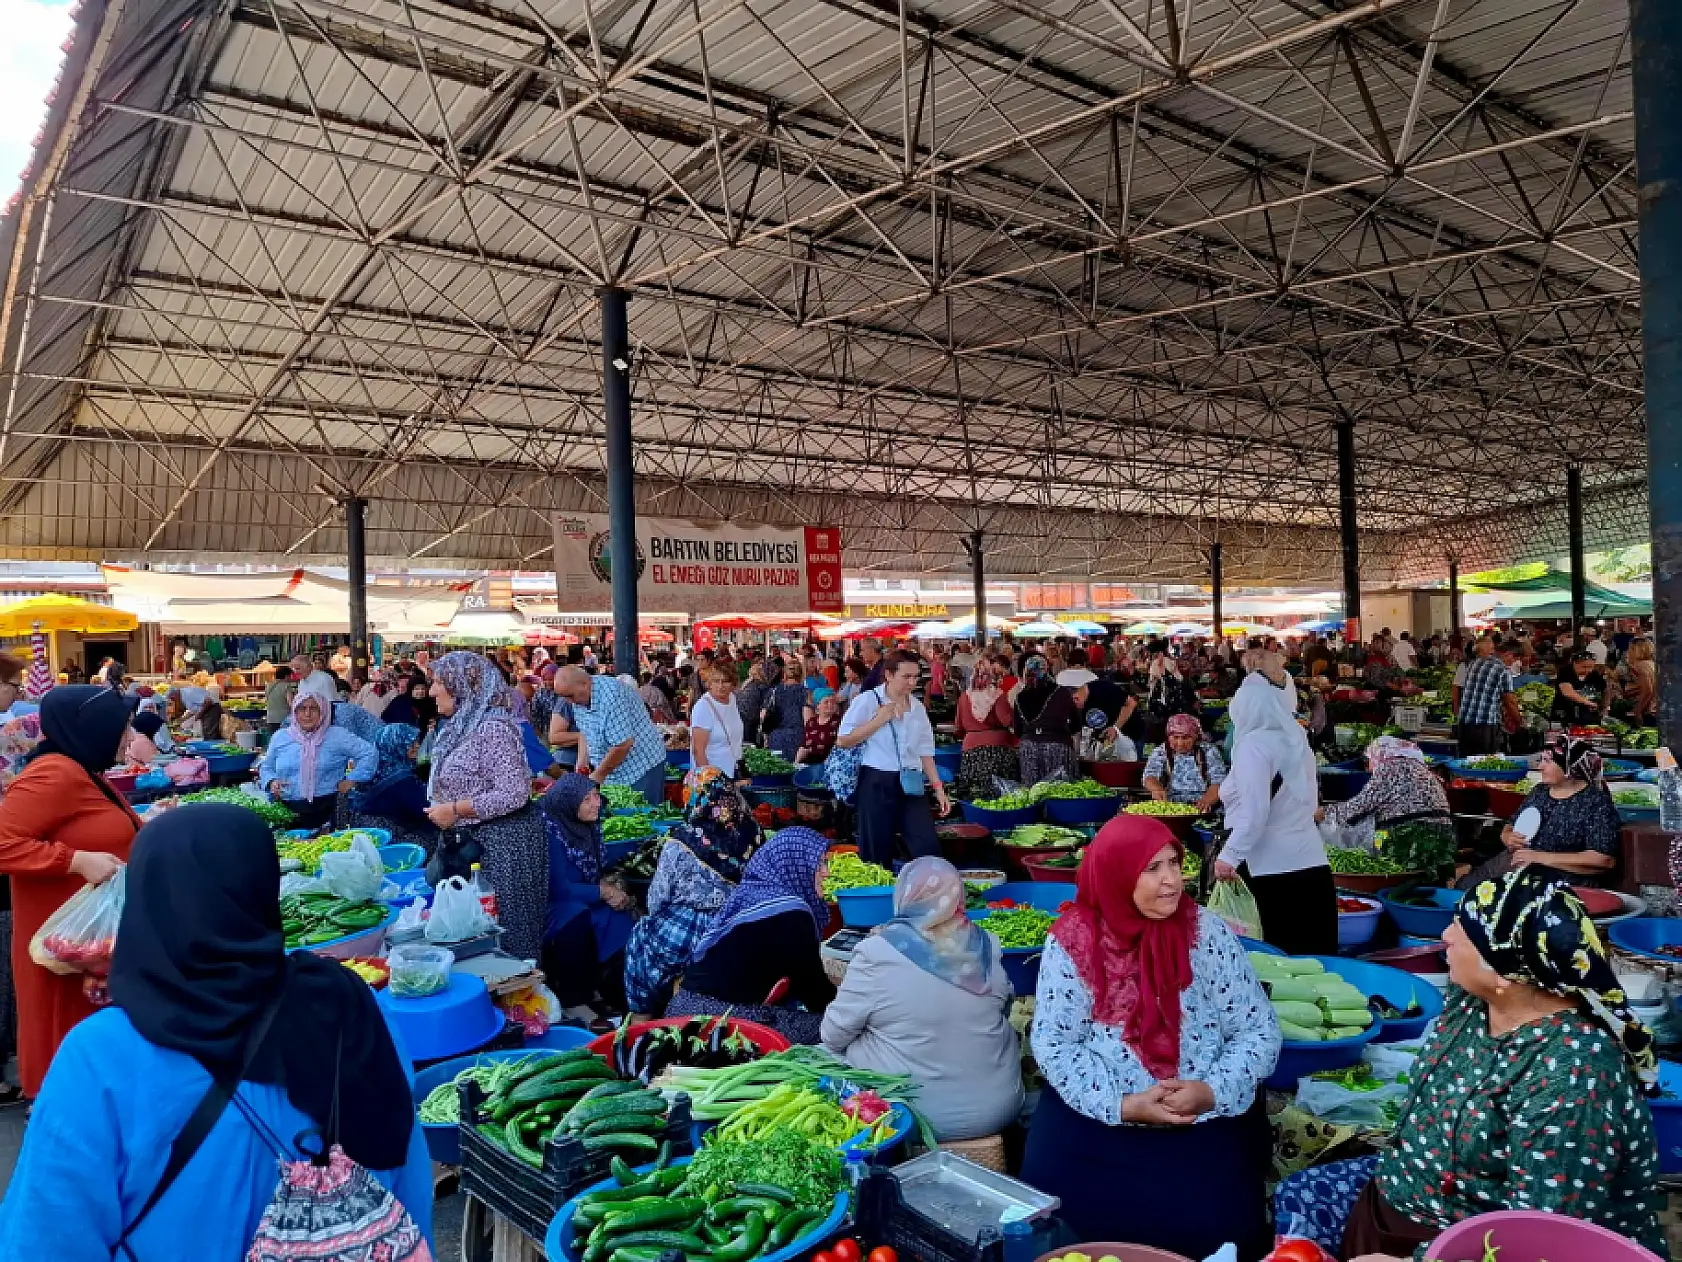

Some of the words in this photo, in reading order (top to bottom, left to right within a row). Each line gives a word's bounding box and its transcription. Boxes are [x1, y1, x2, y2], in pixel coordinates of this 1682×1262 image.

[651, 537, 710, 561] BARTIN
[714, 540, 799, 563] BELEDİYESİ
[652, 565, 668, 584] EL
[732, 568, 761, 586] NURU
[763, 568, 799, 586] PAZARI
